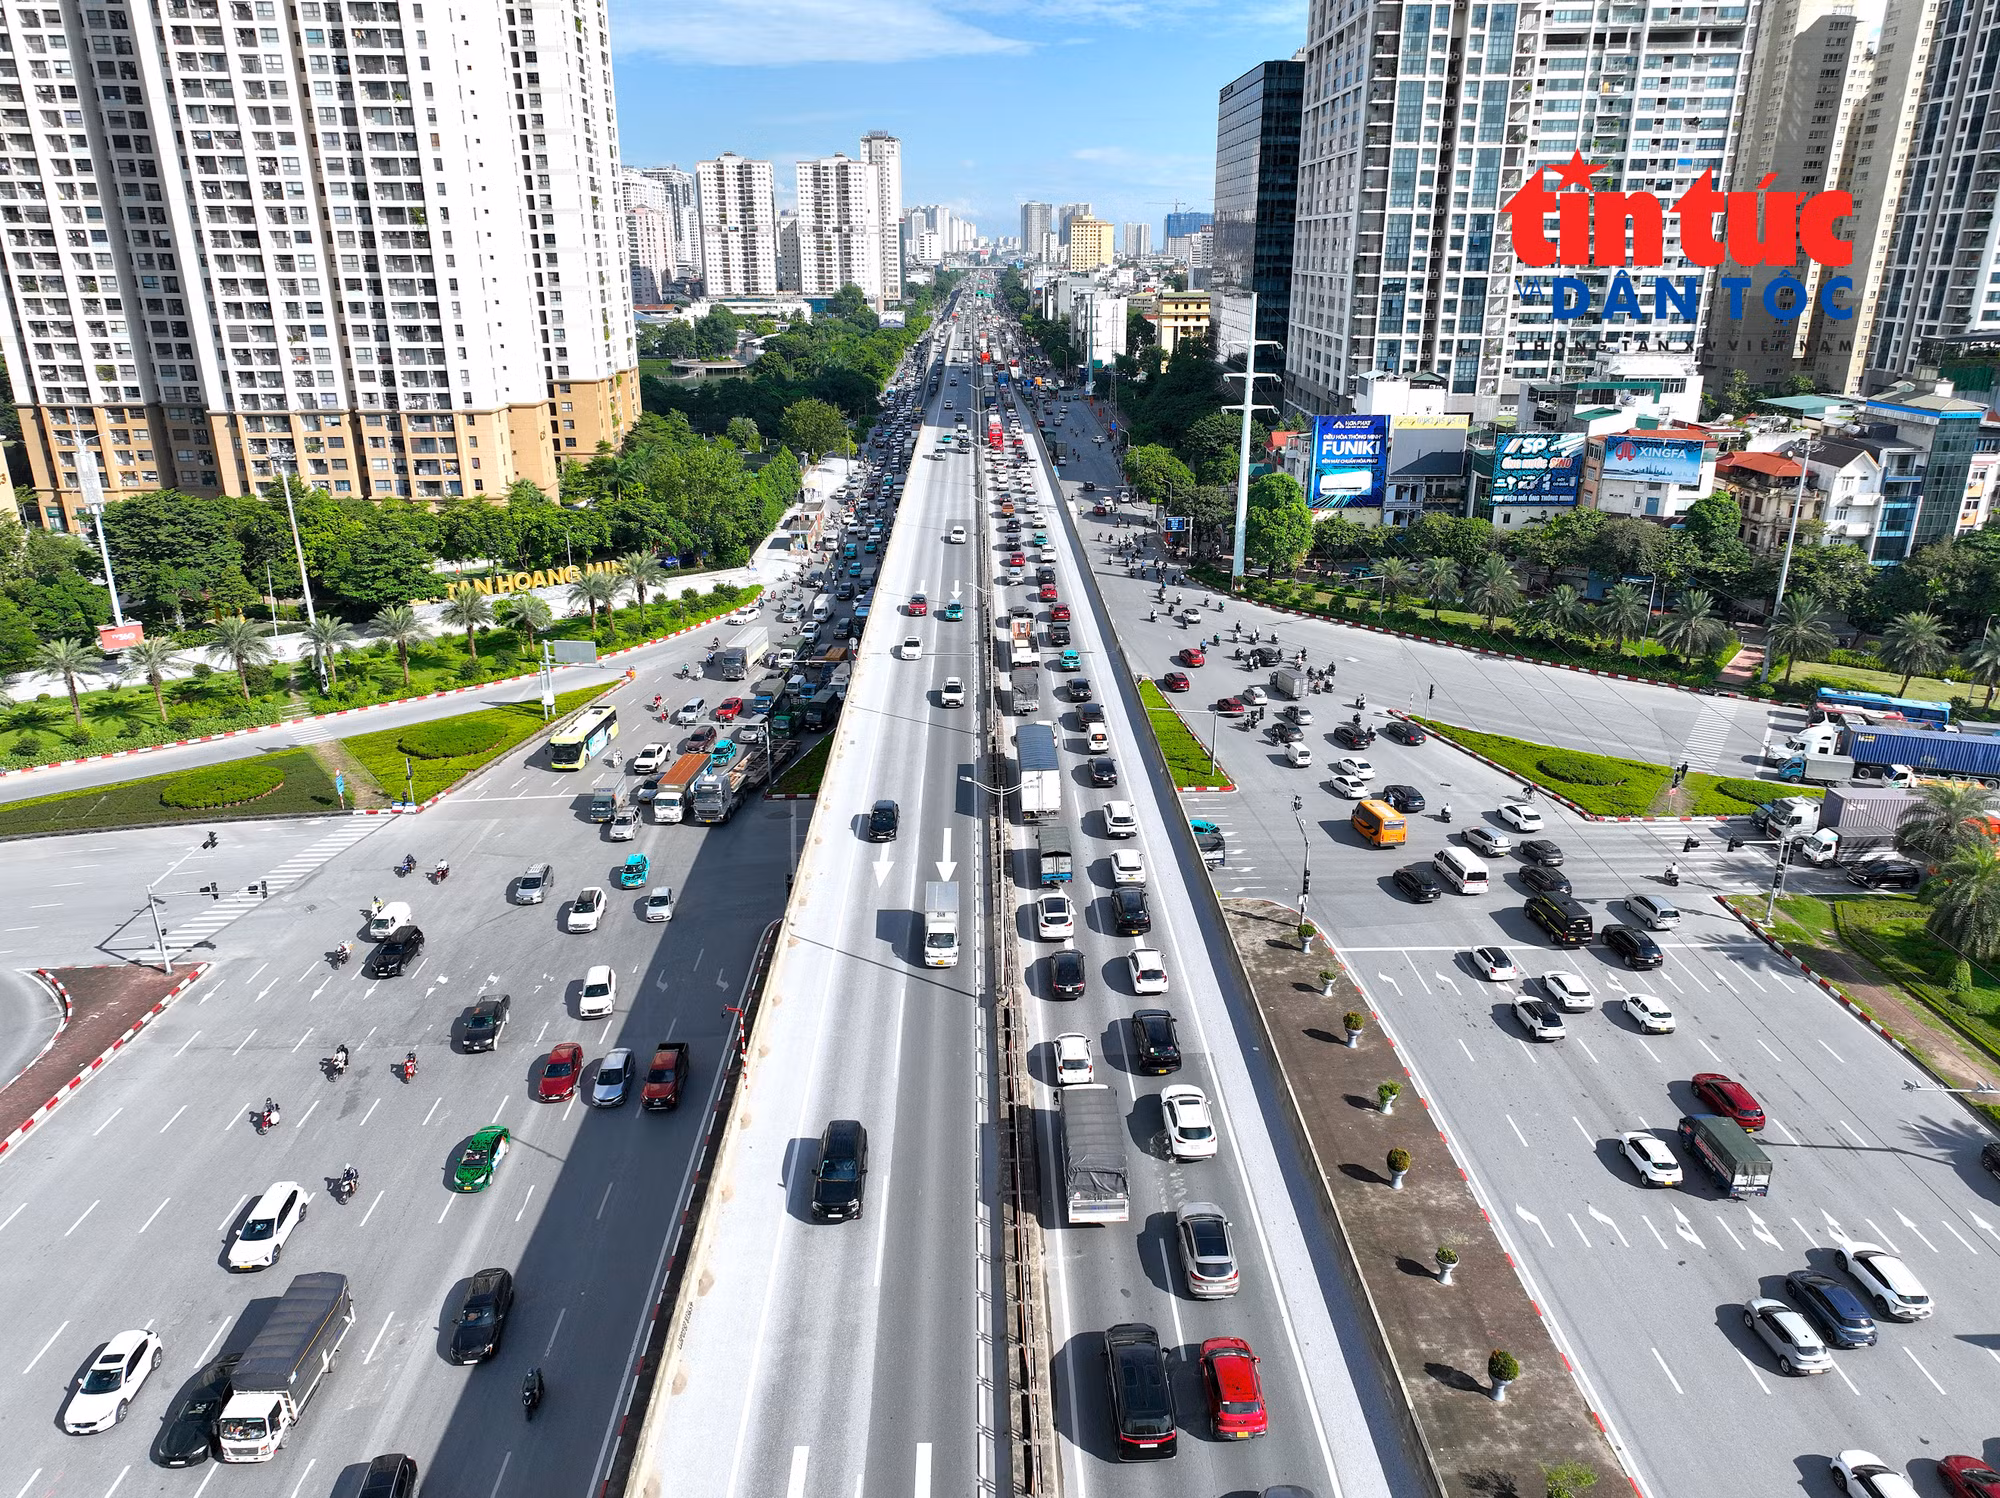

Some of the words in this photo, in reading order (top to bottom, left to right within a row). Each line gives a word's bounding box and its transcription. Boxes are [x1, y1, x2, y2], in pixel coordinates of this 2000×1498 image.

[1322, 440, 1380, 455] FUNIKI
[1521, 438, 1548, 454] SP
[1638, 446, 1687, 459] XINGFA
